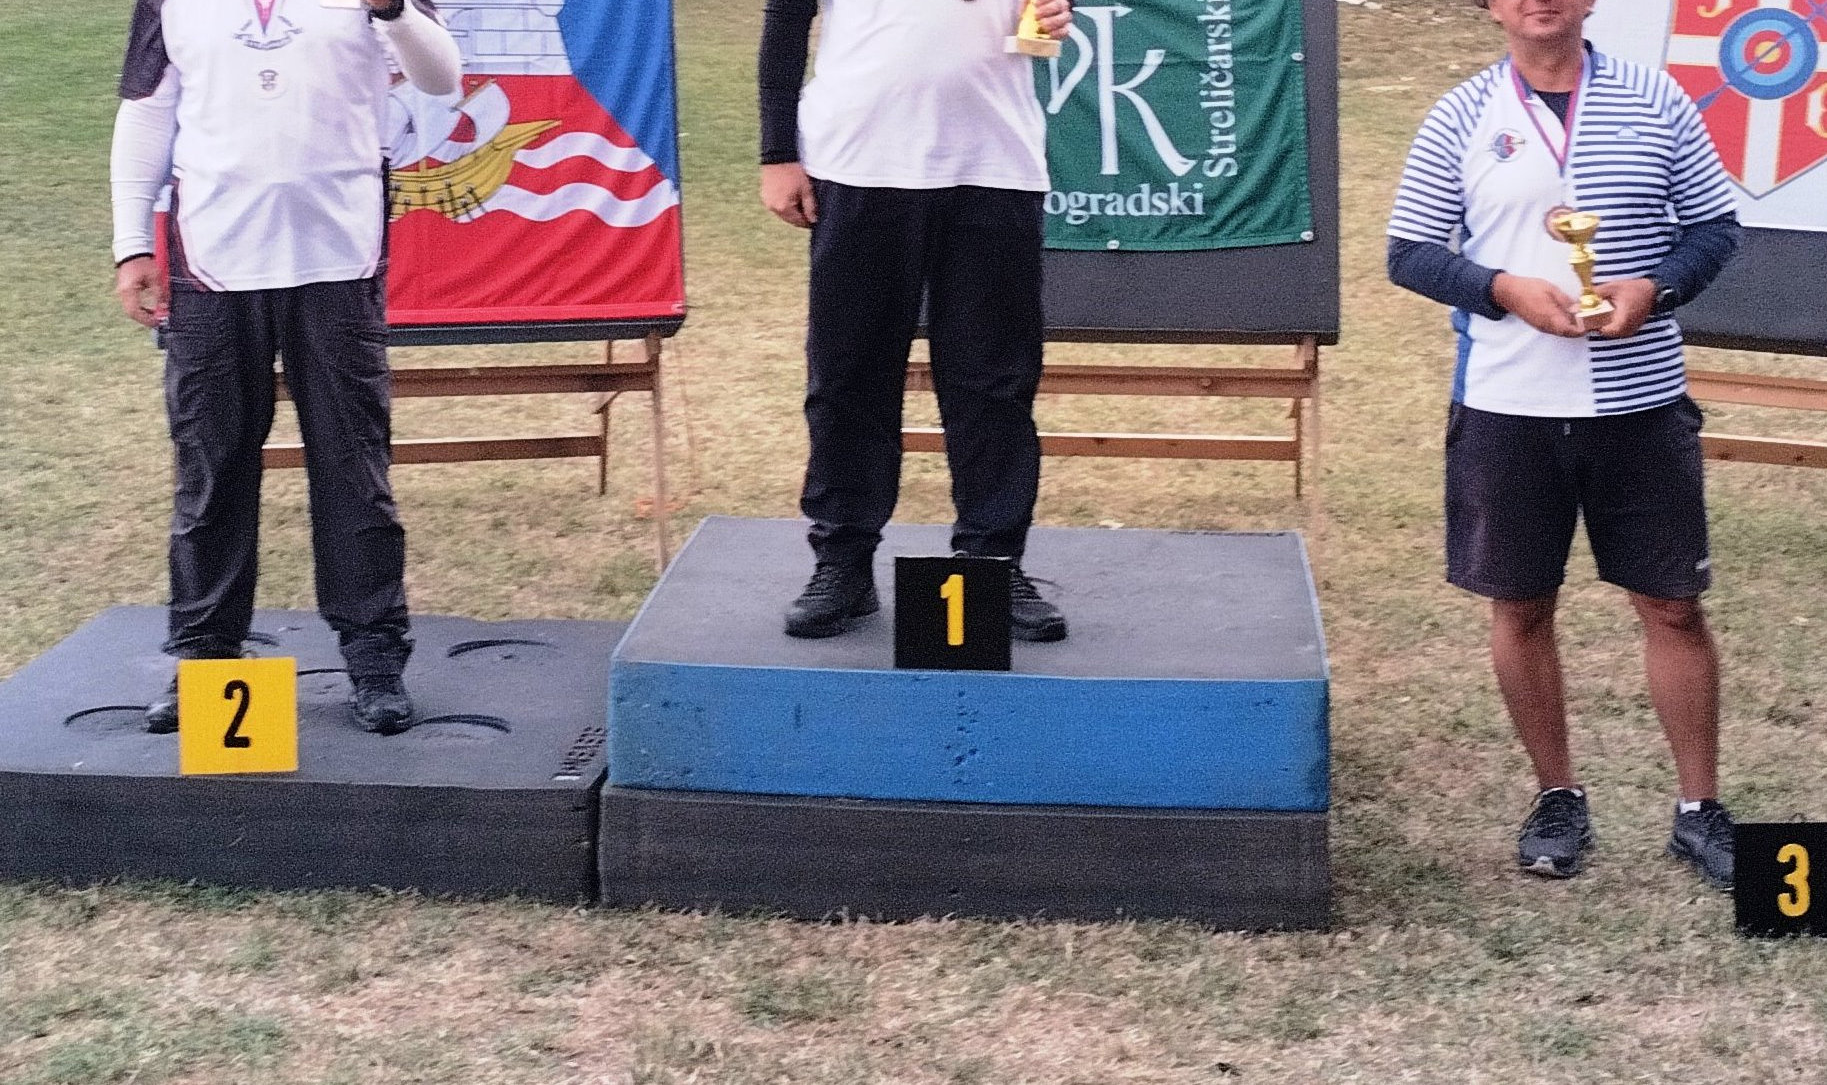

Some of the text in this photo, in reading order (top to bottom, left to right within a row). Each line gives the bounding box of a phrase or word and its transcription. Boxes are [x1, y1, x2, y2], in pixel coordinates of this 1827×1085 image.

[940, 574, 964, 646] 1
[223, 679, 251, 748] 2
[1776, 843, 1811, 917] 3
